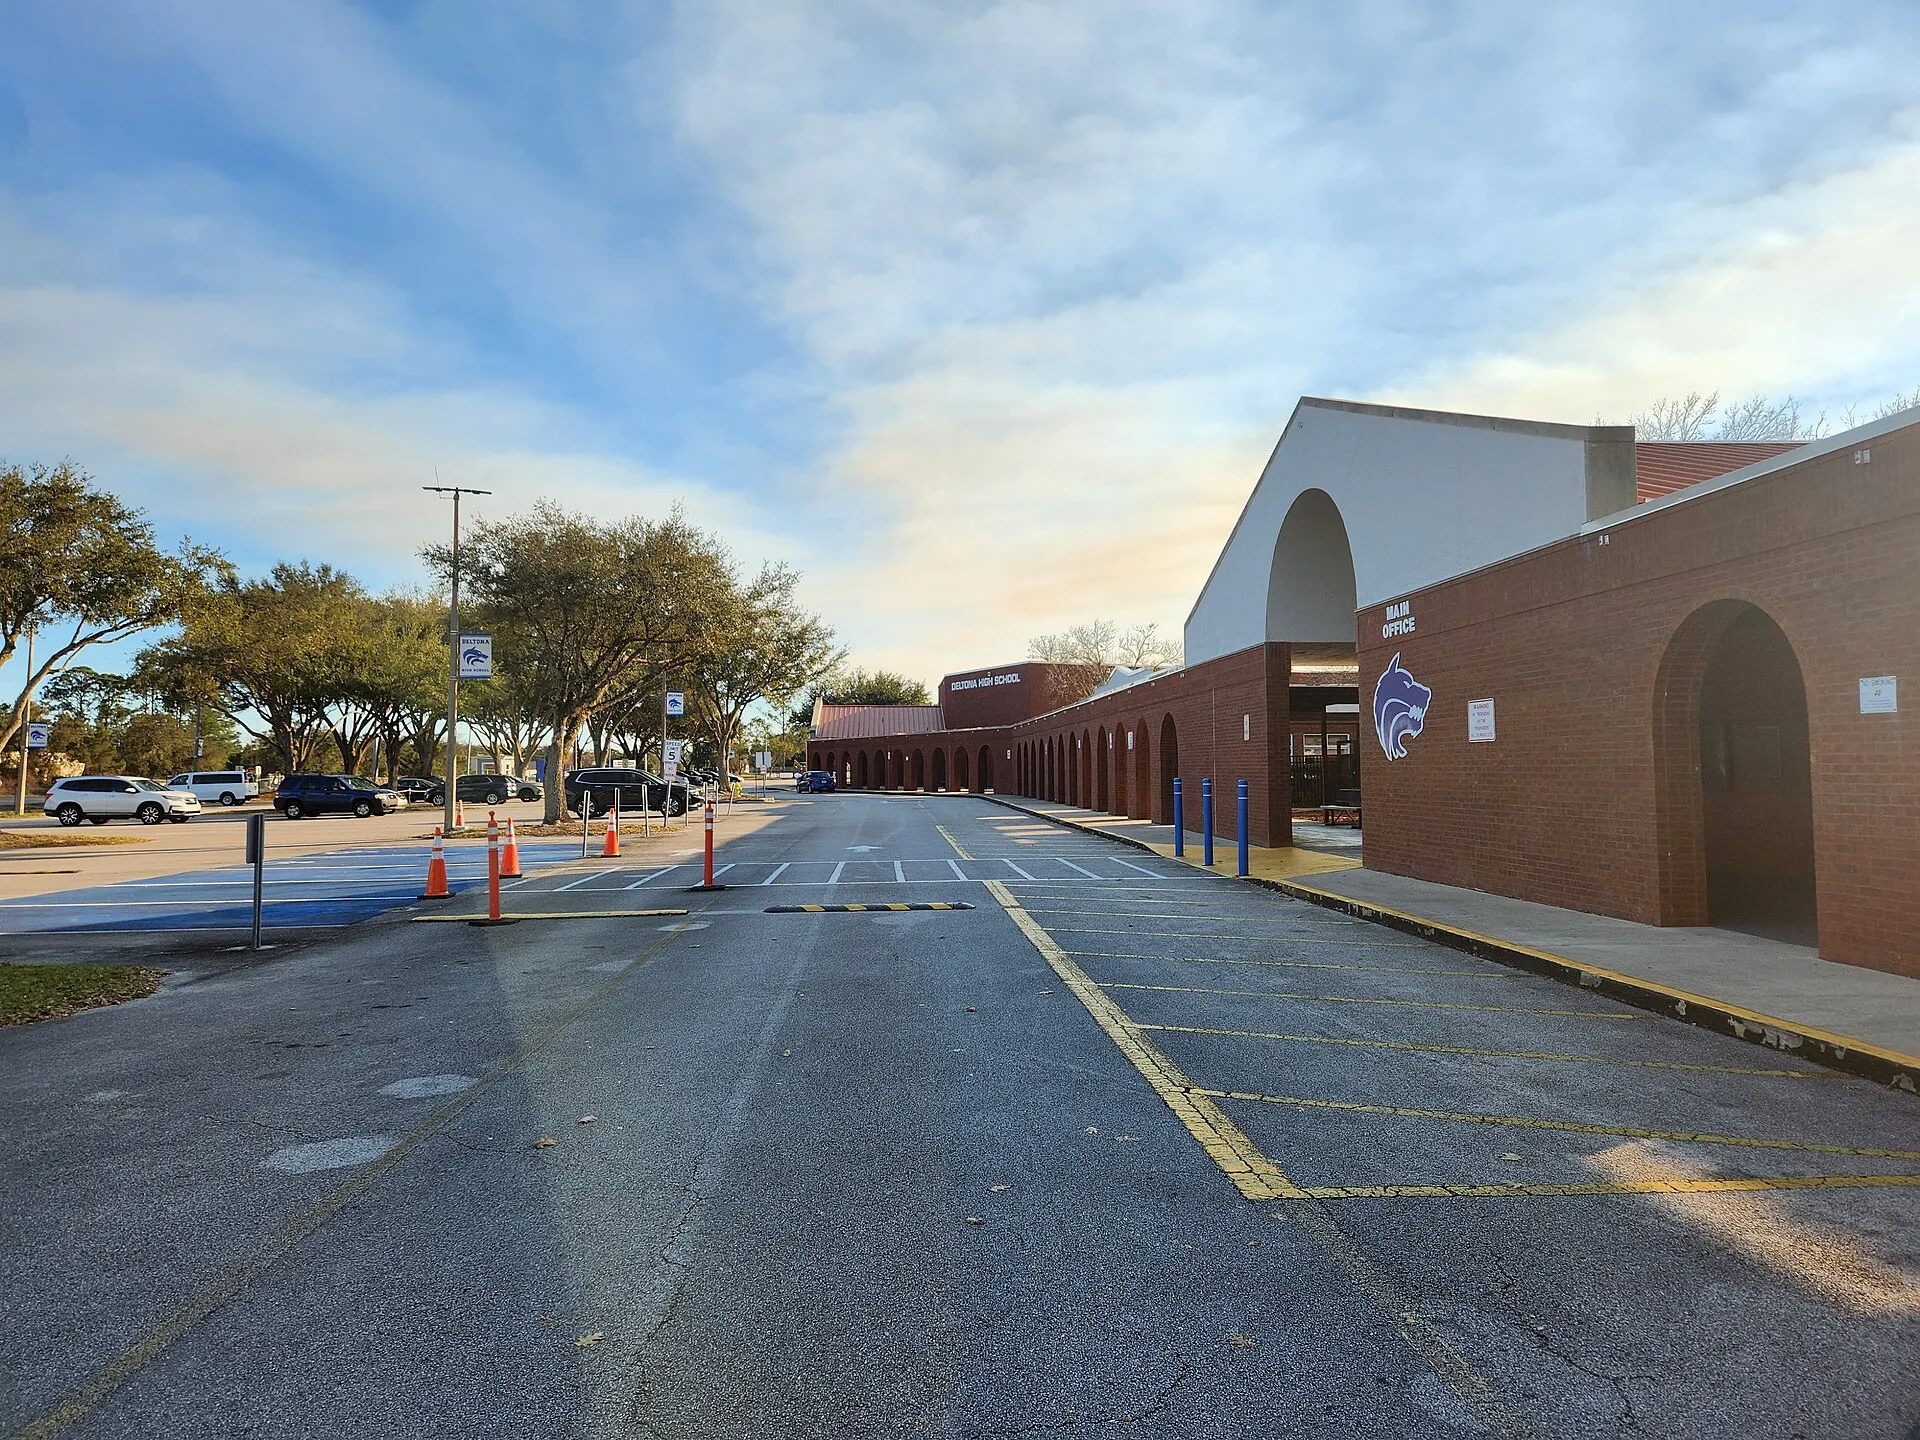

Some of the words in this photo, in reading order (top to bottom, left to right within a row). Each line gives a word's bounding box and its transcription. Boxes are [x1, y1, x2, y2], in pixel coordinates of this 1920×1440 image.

[1386, 600, 1410, 621] MAIN
[1382, 616, 1416, 639] OFFICE
[951, 679, 977, 691] DELTONA
[978, 676, 993, 688] HIGH
[994, 673, 1021, 686] SCHOOL
[668, 751, 676, 761] 5
